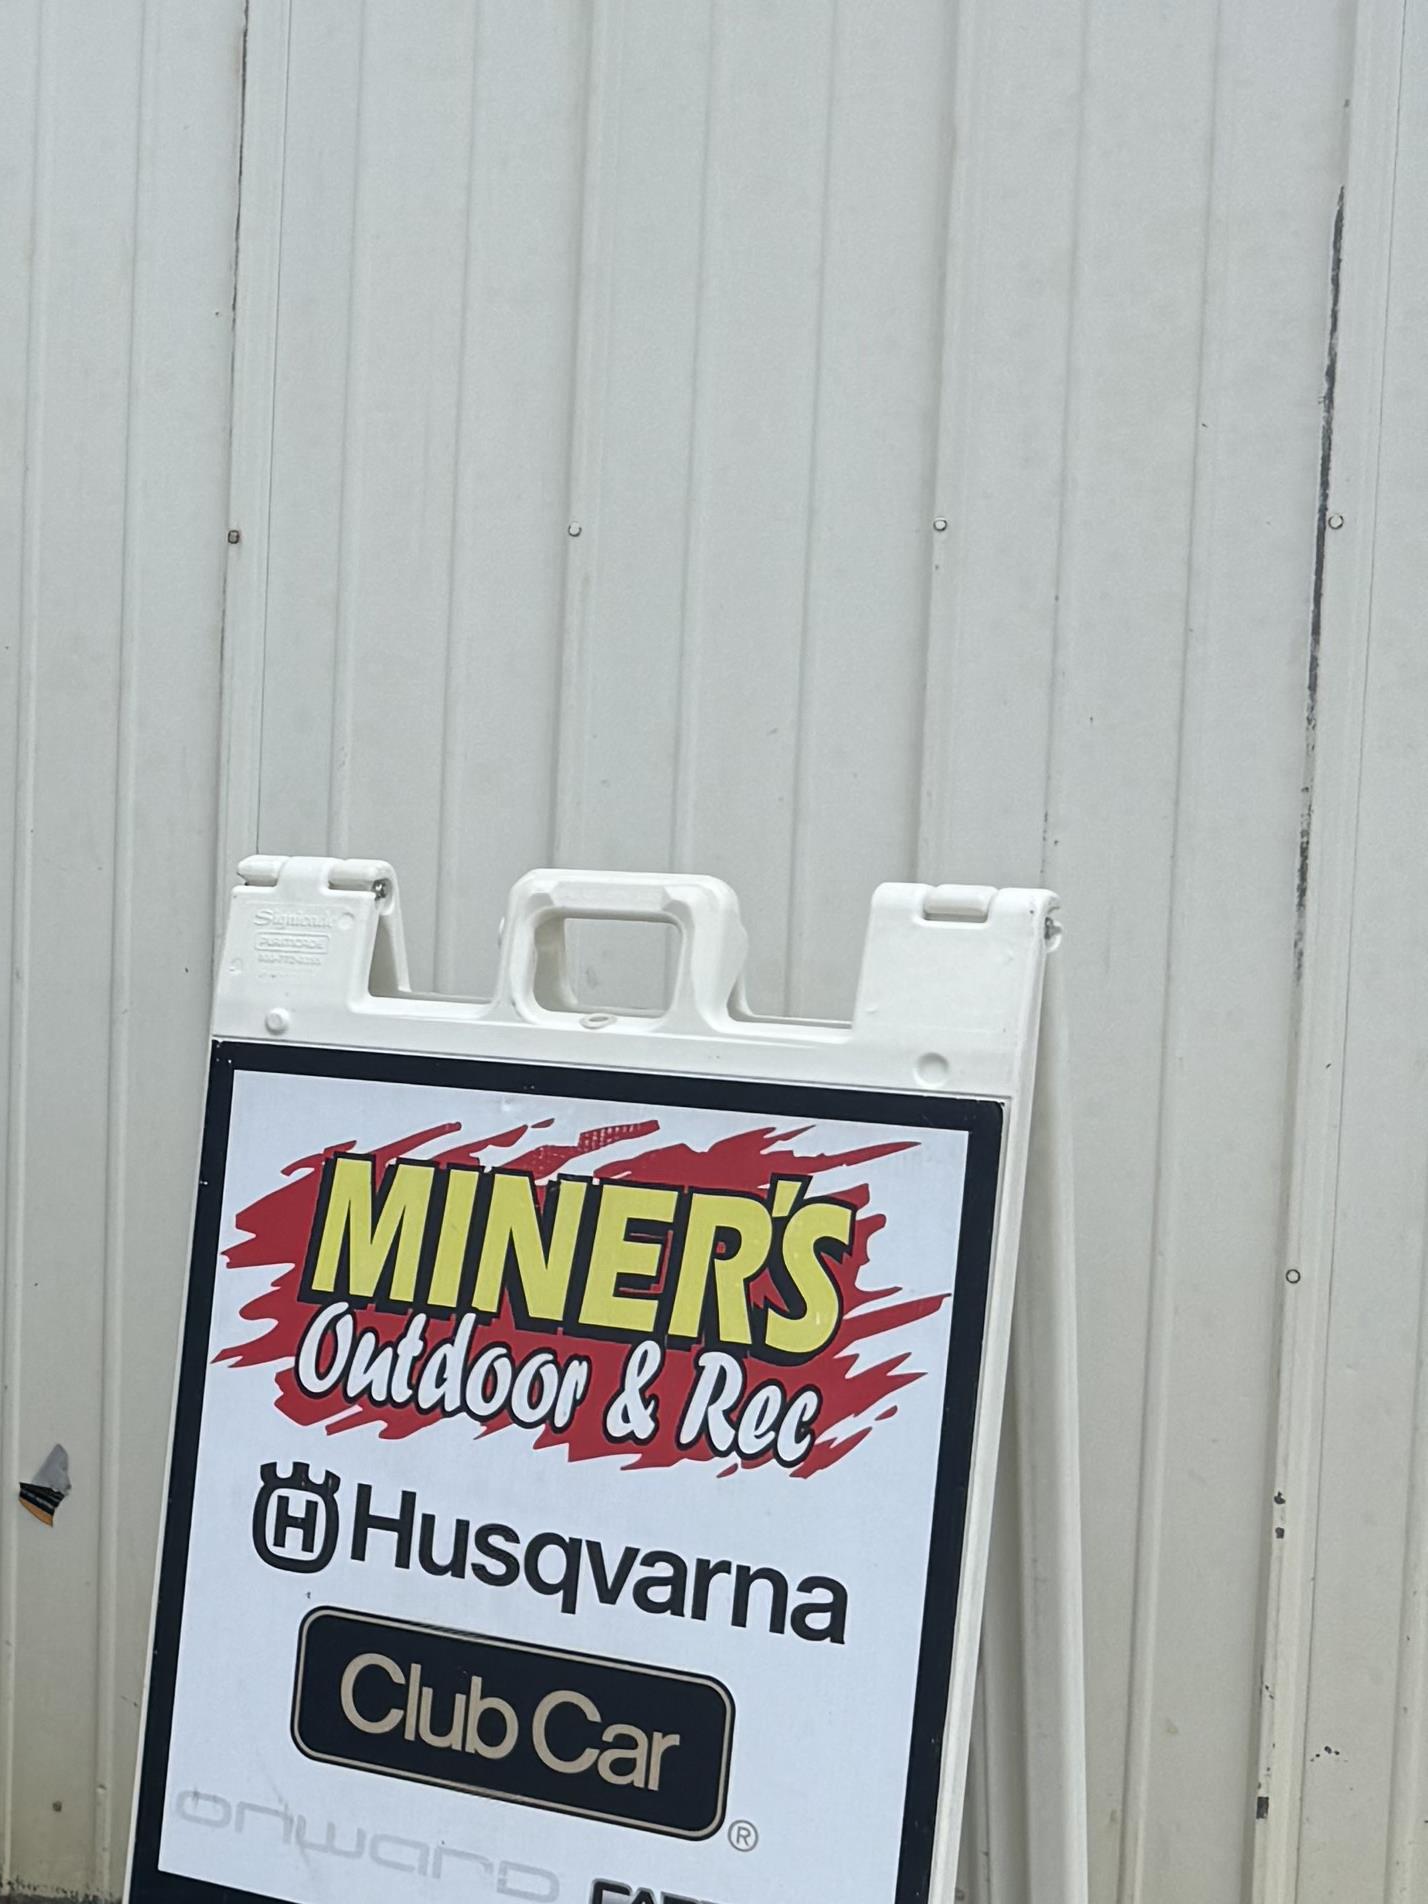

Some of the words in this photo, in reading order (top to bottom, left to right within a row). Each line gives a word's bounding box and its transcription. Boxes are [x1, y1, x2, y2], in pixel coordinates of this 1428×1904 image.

[306, 1154, 854, 1358] MINER'S
[297, 1302, 587, 1428] Outdoor
[606, 1341, 664, 1442] &
[679, 1352, 821, 1467] Rec
[350, 1483, 849, 1644] Husqvarna
[340, 1653, 519, 1759] Club
[532, 1690, 681, 1791] Car
